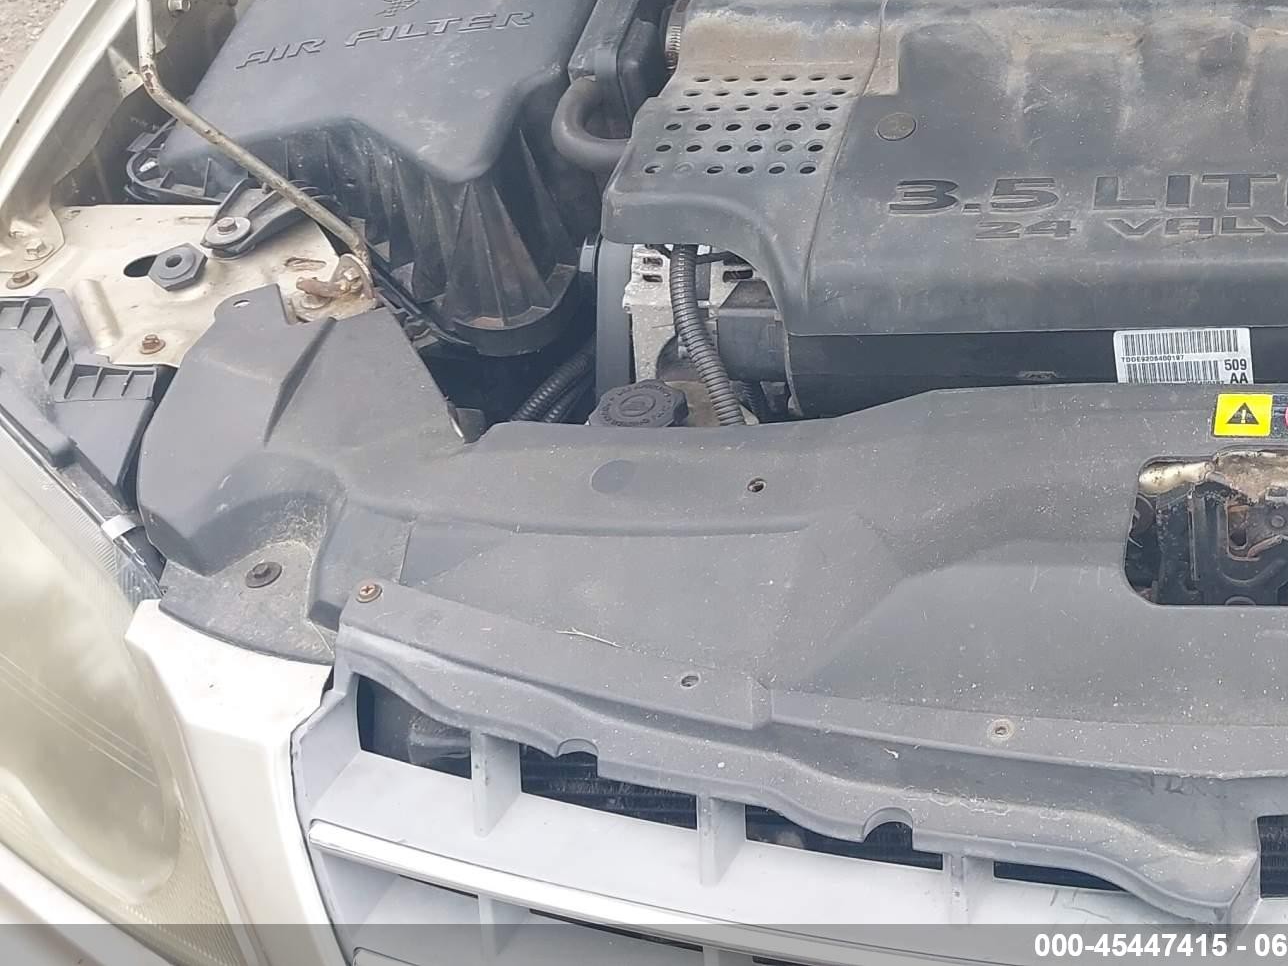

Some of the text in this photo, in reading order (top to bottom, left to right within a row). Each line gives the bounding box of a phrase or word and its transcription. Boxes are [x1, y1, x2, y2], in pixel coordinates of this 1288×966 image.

[236, 12, 534, 69] AIR FILTER
[888, 178, 1059, 217] 3.5
[976, 218, 1077, 240] 24
[1224, 359, 1247, 371] 509
[1229, 372, 1248, 384] AA
